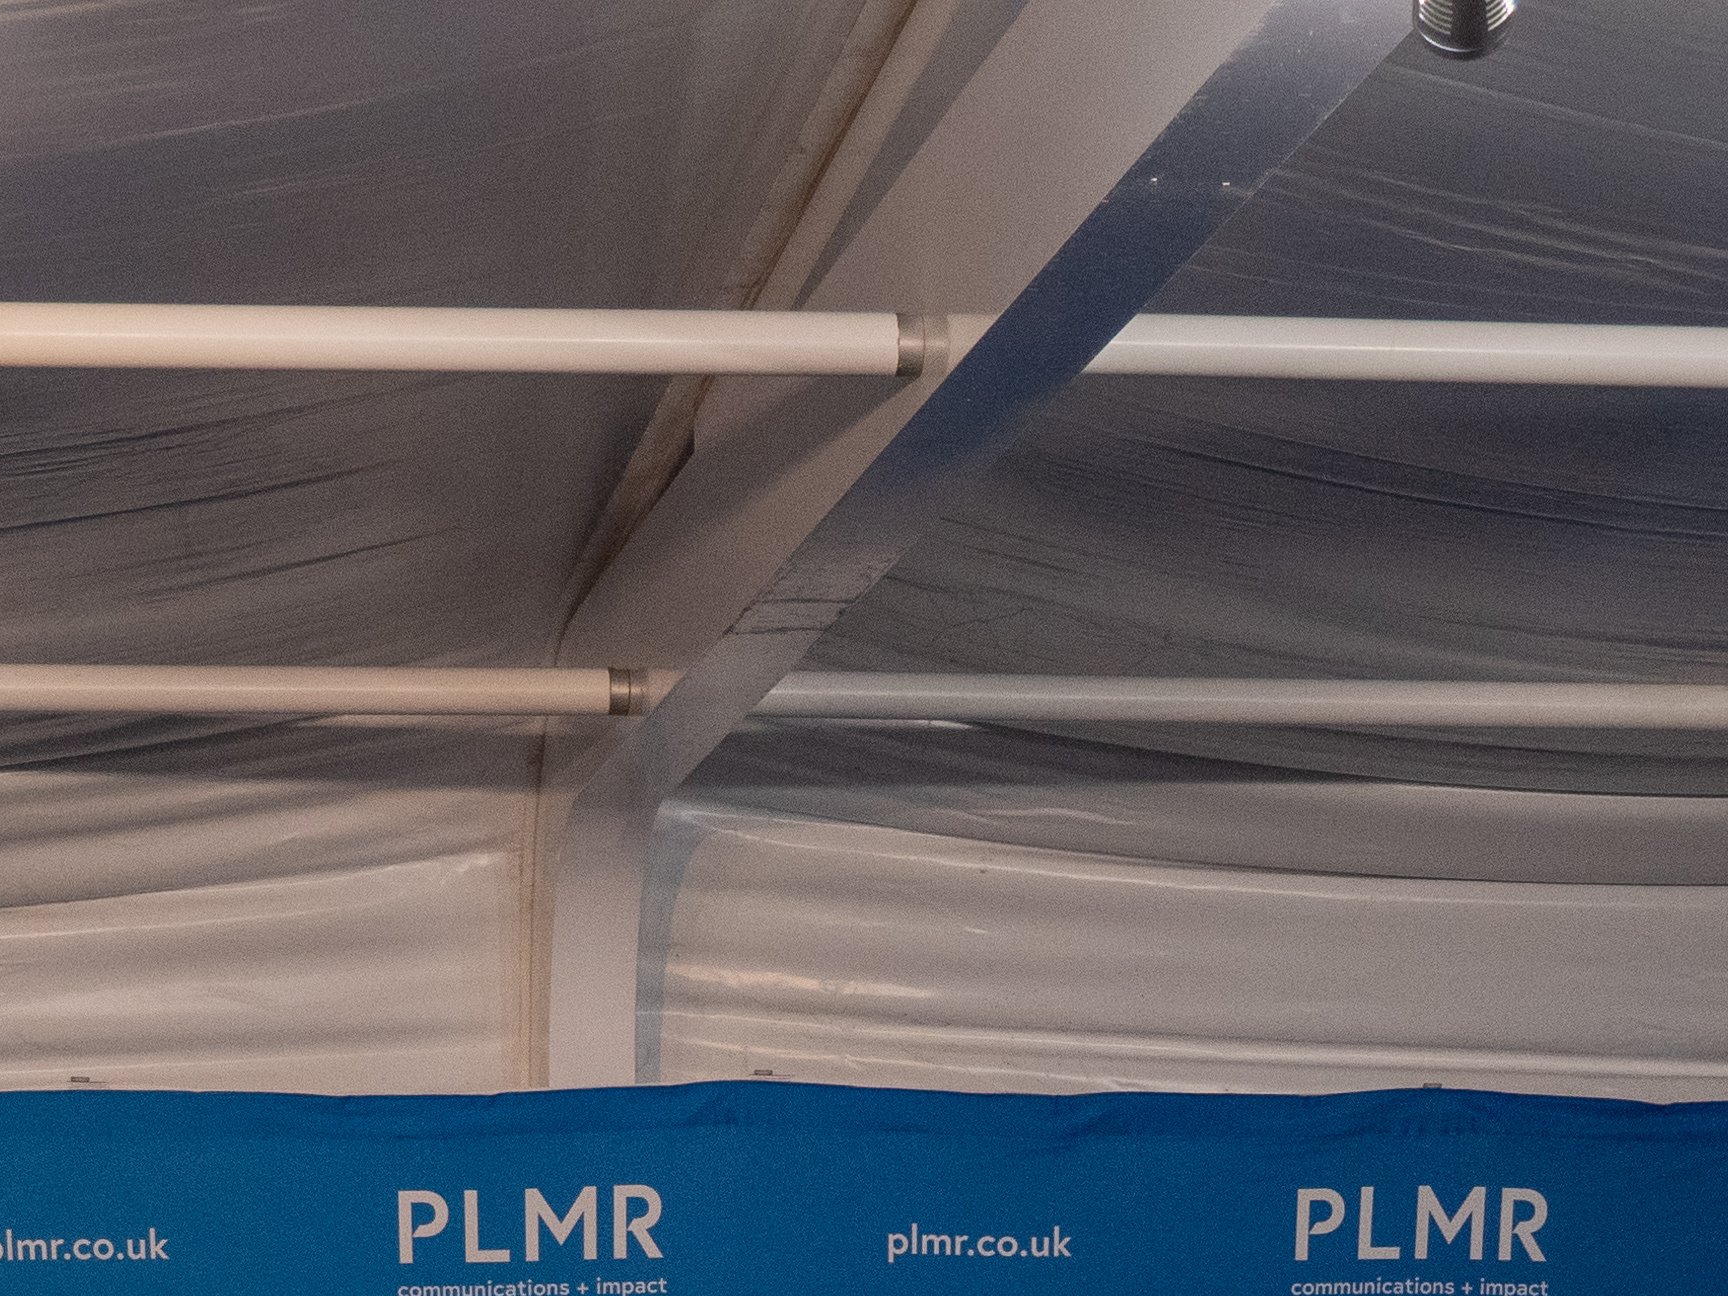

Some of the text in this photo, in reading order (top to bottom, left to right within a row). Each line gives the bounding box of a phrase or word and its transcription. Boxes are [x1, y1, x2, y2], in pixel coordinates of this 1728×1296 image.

[397, 1183, 664, 1264] PLMR
[887, 1222, 1072, 1264] plmr.co.uk
[1294, 1185, 1549, 1263] PLMR
[577, 1282, 589, 1295] +
[1290, 1276, 1455, 1296] communications
[1461, 1282, 1473, 1295] +
